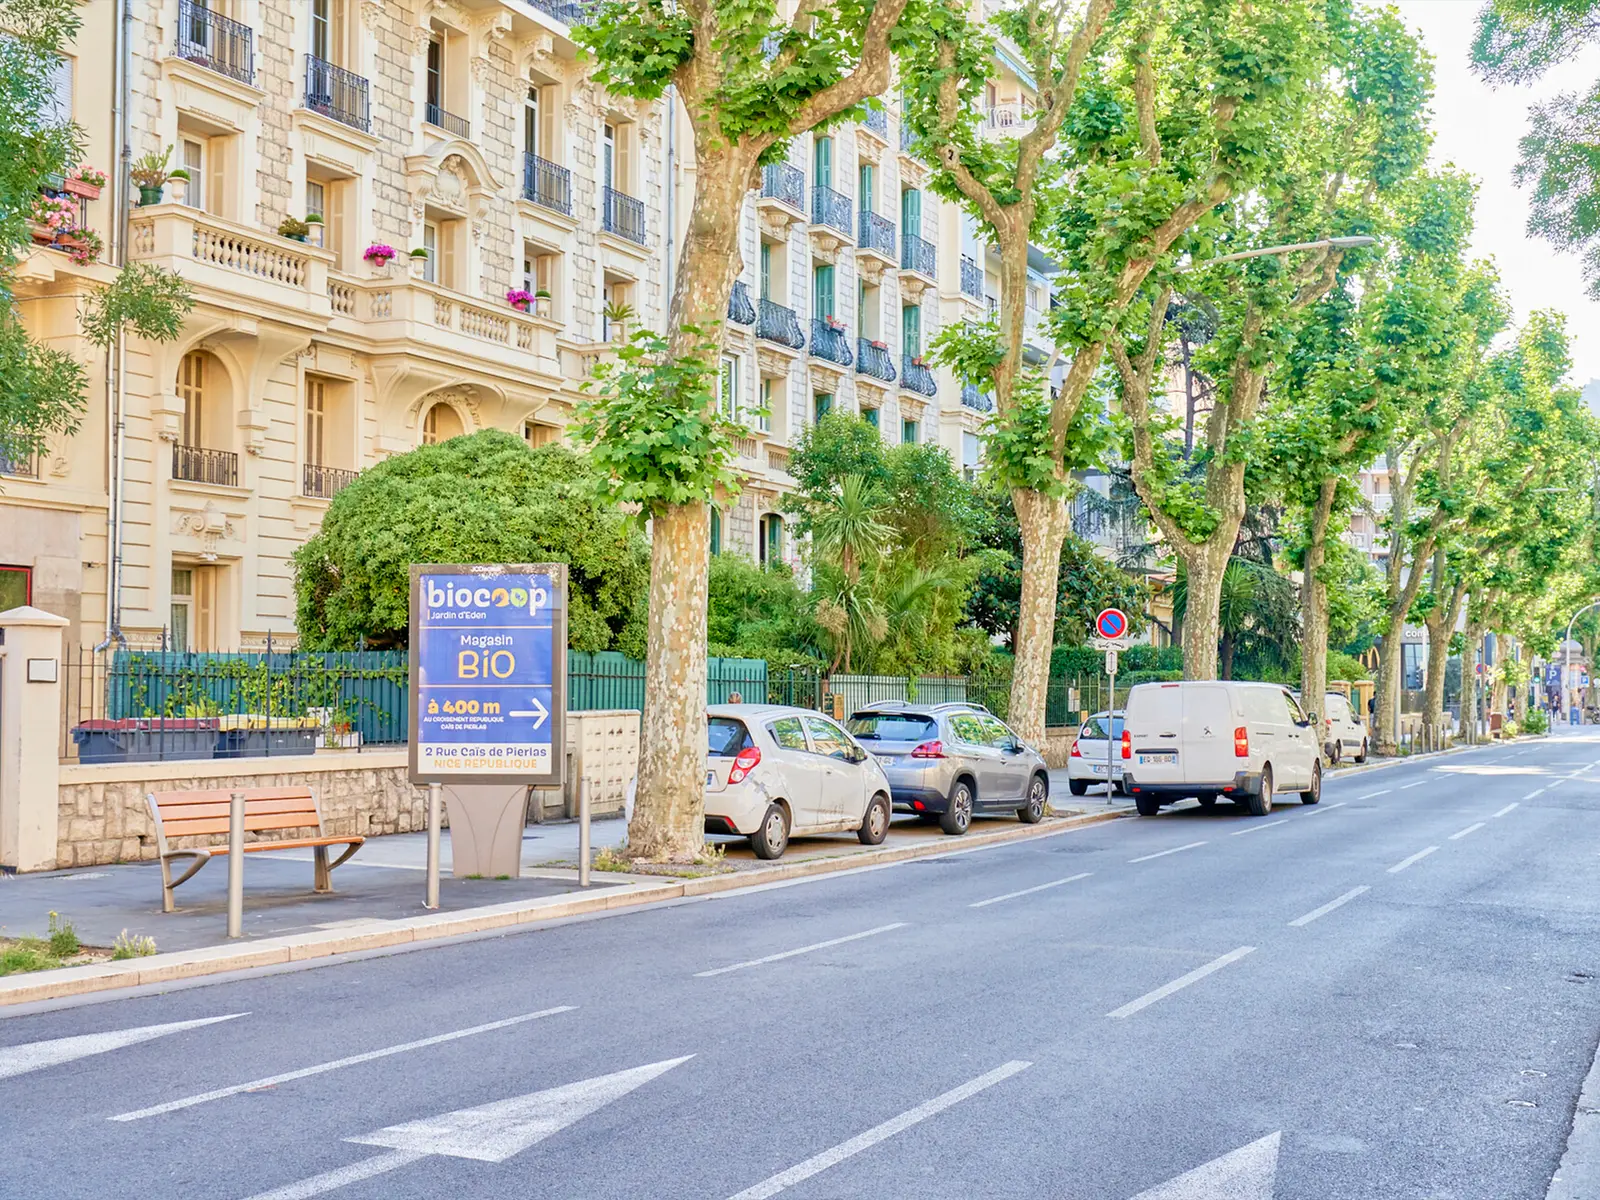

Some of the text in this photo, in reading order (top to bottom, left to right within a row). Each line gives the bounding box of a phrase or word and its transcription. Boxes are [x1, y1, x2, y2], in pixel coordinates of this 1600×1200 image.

[428, 580, 547, 617] biocoop
[430, 611, 487, 620] Jardin d'Eden
[460, 635, 513, 648] Magasin
[427, 698, 501, 715] à 400 m
[425, 746, 547, 757] 2 Rue Caïs de Pierlas
[434, 759, 461, 769] NICE
